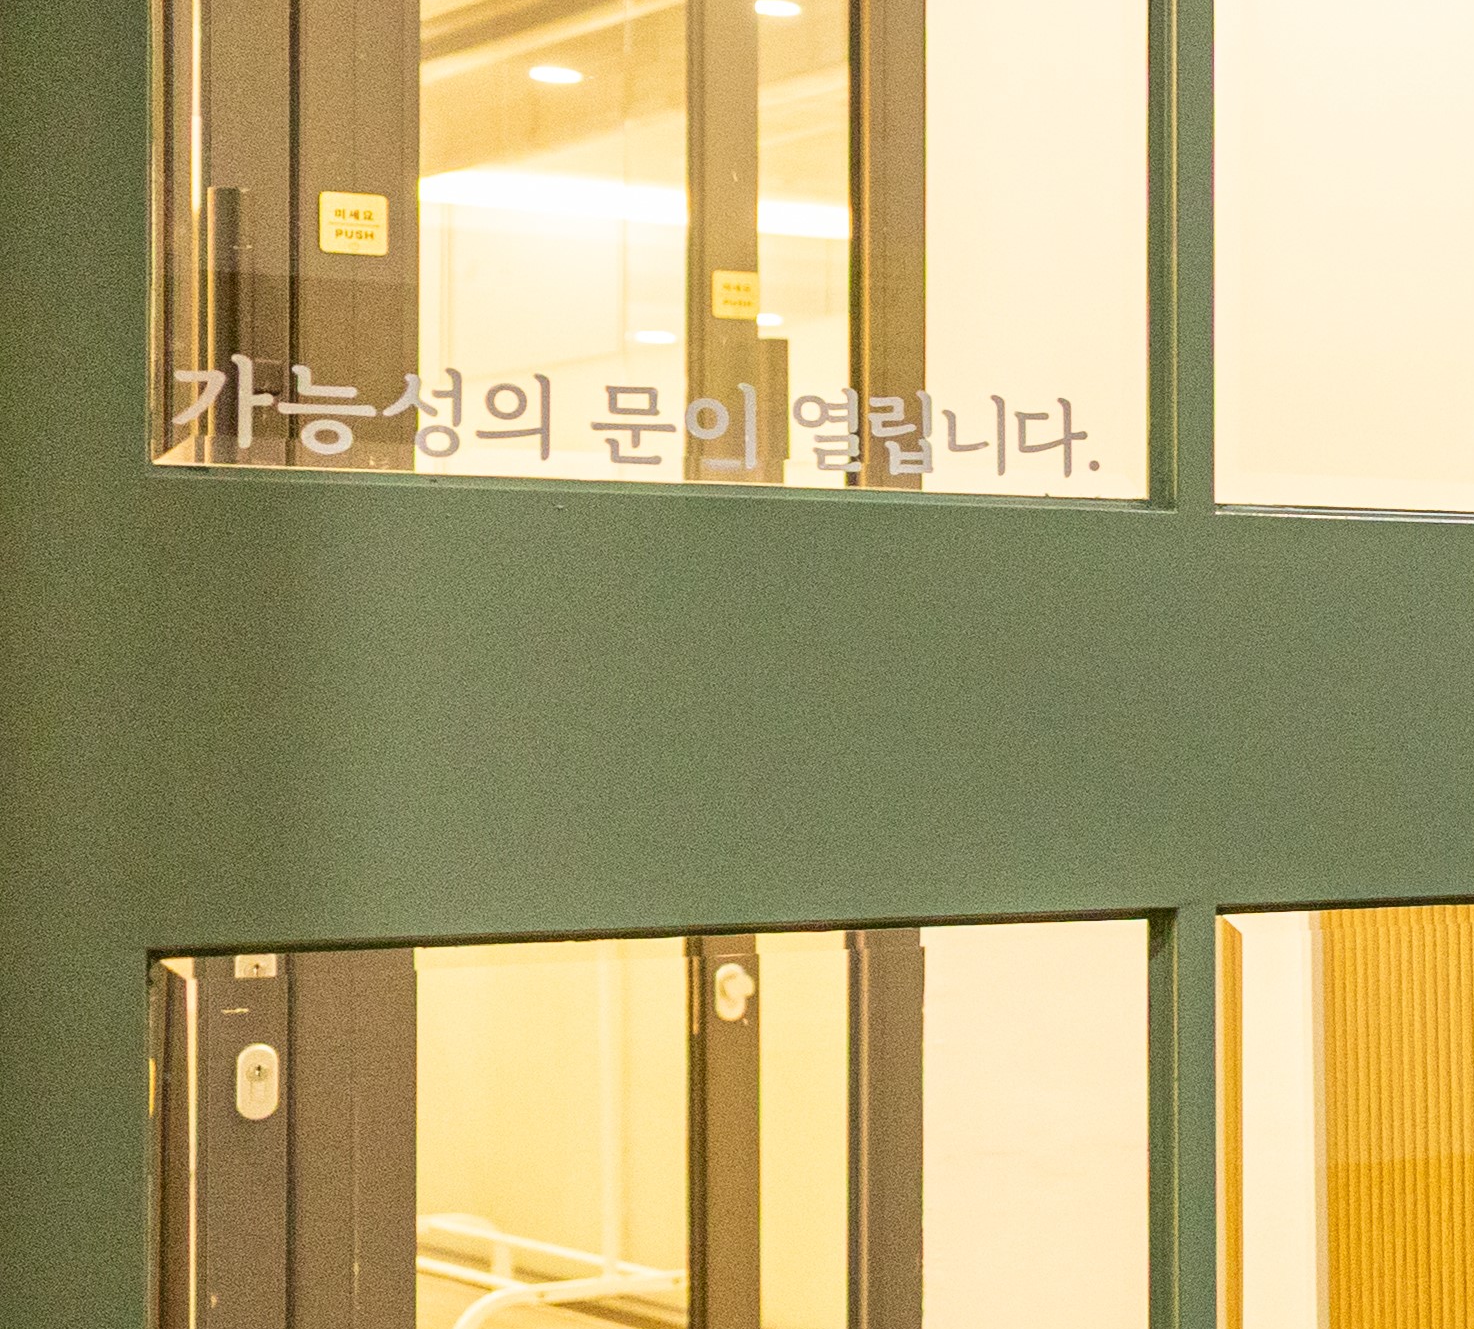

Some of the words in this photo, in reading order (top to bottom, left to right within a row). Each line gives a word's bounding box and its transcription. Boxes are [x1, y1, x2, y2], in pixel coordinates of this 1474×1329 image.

[334, 209, 374, 221] 미세요
[335, 228, 376, 241] PUSH
[171, 352, 553, 460] 가능성의
[590, 382, 757, 469] 문이
[792, 388, 1101, 479] 열립니다.
